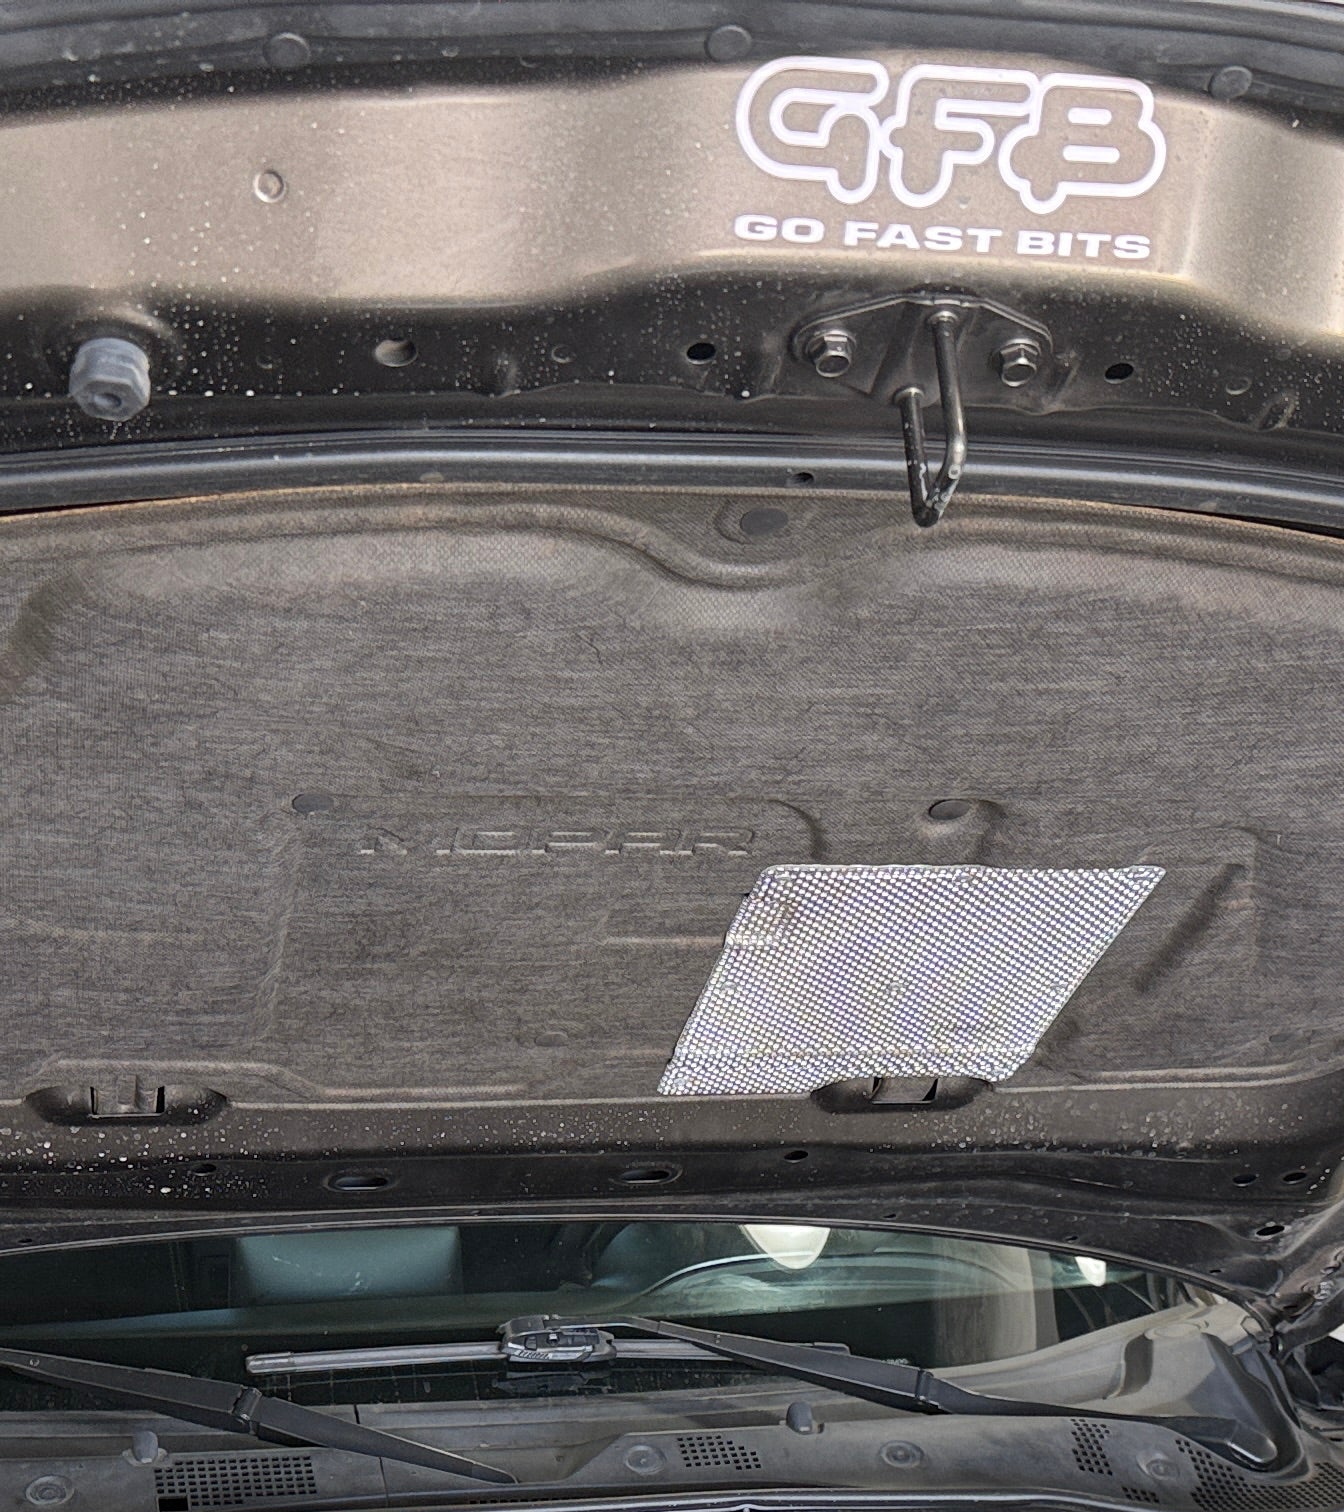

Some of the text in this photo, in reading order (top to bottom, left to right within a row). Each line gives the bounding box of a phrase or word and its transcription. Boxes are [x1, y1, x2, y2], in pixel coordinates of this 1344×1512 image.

[735, 55, 1167, 215] GFB
[733, 213, 1152, 260] GO FAST BITS
[358, 826, 755, 857] MOPAR
